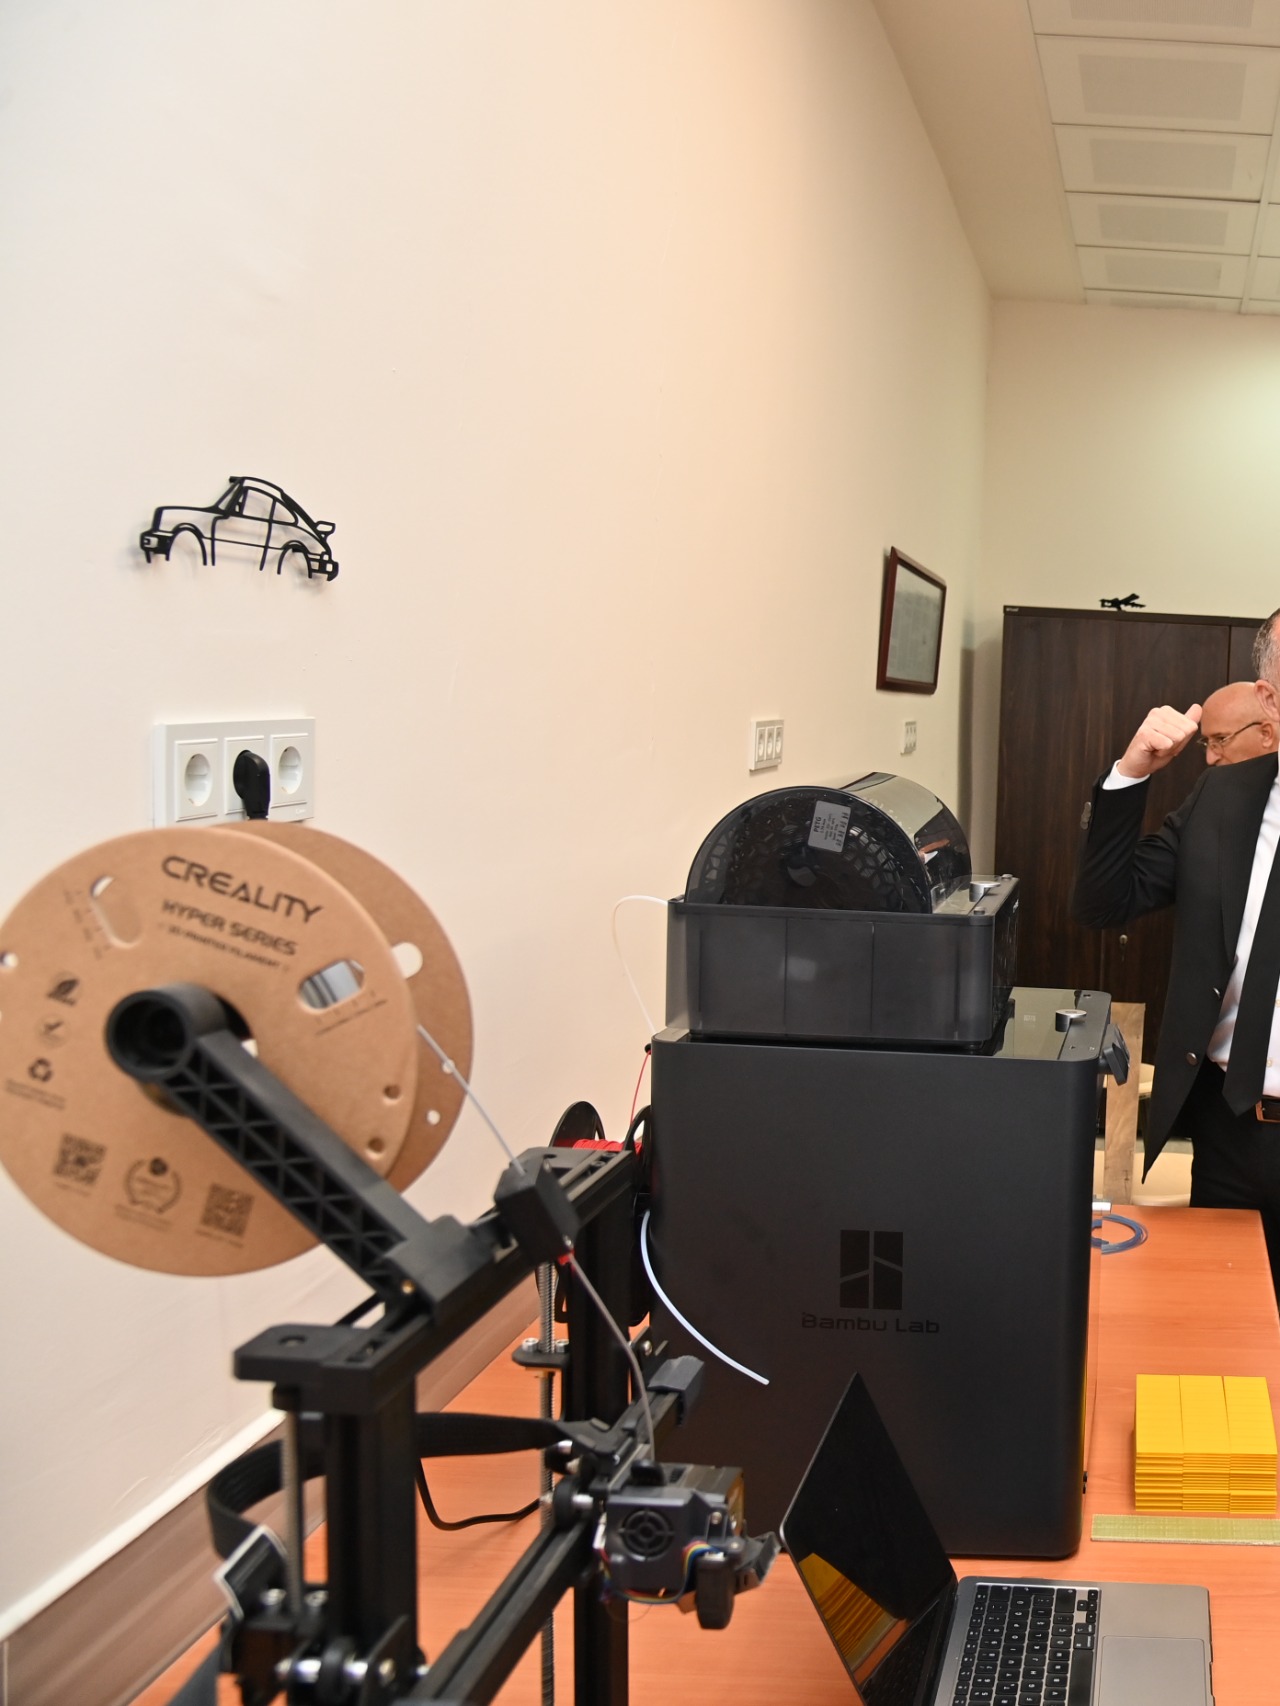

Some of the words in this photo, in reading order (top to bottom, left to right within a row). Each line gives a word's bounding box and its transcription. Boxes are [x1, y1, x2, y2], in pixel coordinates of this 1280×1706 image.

[161, 855, 323, 923] CREALITY
[162, 899, 226, 932] HYPER
[229, 921, 298, 956] SERIES
[801, 1312, 887, 1332] Bambu
[895, 1318, 940, 1334] Lab
